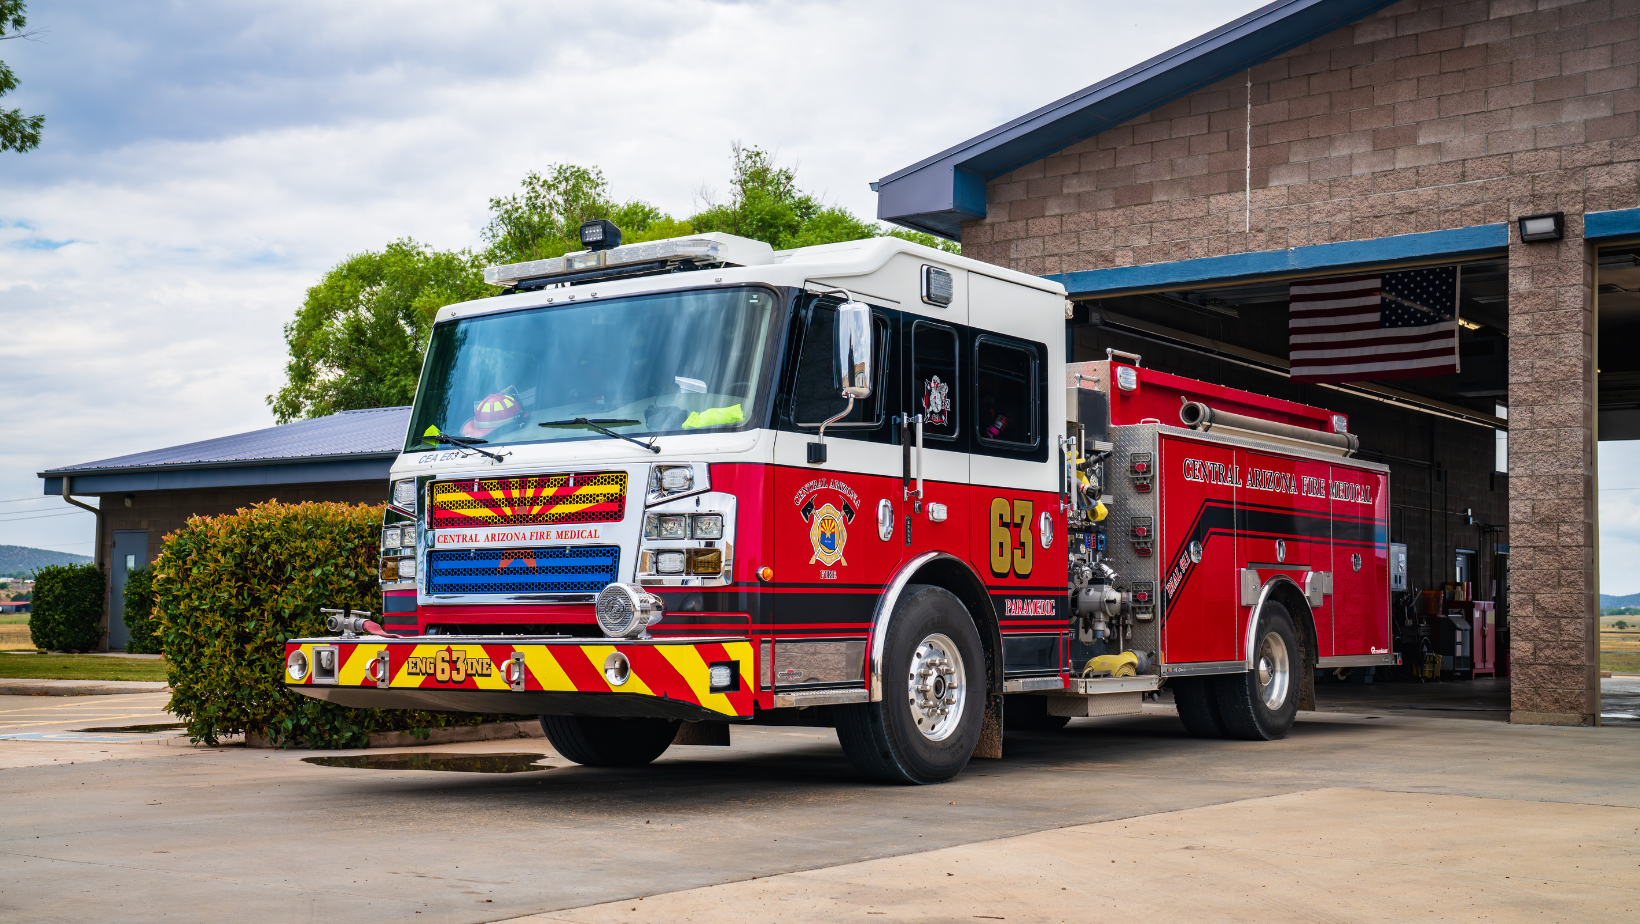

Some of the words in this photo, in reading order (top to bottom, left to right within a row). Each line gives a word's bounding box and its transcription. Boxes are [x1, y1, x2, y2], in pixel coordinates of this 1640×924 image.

[418, 453, 439, 464] CEA
[1182, 457, 1242, 488] CENTRAL
[1245, 467, 1298, 495] ARIZONA
[1301, 475, 1326, 499] FIRE
[1328, 479, 1373, 505] MEDICAL
[793, 478, 828, 506] CENTRAL
[828, 478, 861, 510] ARIZONA
[436, 533, 480, 544] CENTRAL
[483, 531, 527, 543] ARIZONA
[528, 530, 552, 541] FIRE
[555, 528, 600, 540] MEDICAL
[989, 496, 1034, 580] 63
[820, 569, 838, 580] FIRE
[1165, 566, 1183, 600] DIAL
[1179, 549, 1191, 574] 911
[1004, 598, 1056, 617] PARAMEDIC
